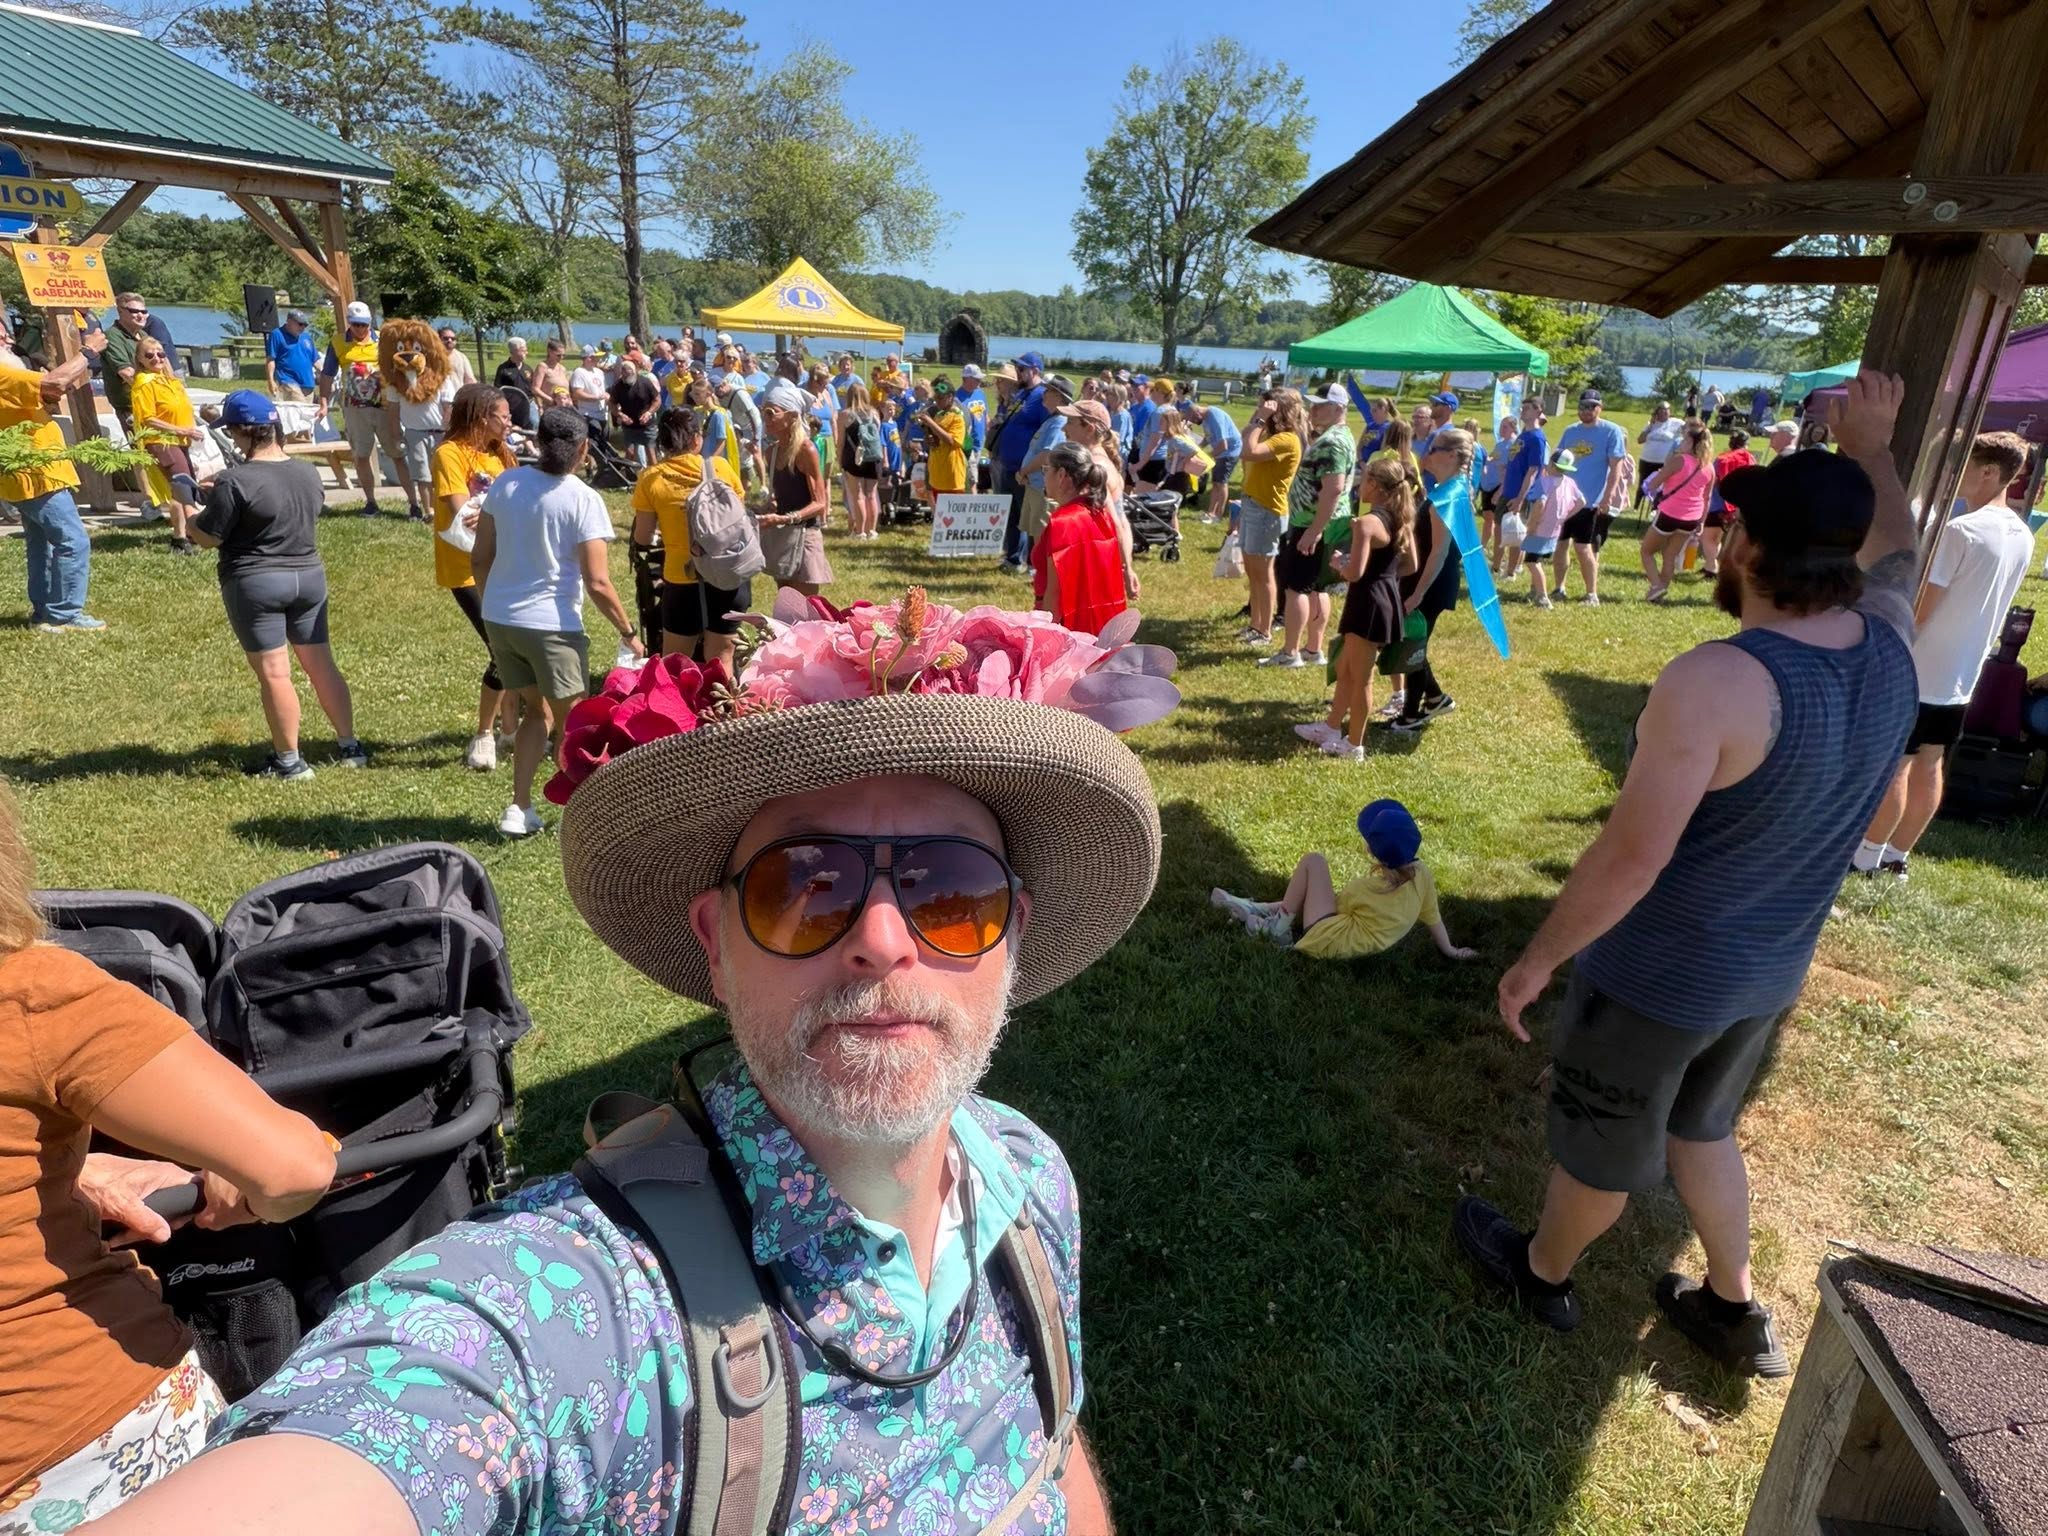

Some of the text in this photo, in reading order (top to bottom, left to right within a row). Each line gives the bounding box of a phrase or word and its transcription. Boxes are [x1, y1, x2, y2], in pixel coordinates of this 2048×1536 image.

[46, 278, 88, 289] CLAIRE
[33, 287, 107, 299] GABELMANN
[947, 500, 1001, 514] YOUR PRESENCE
